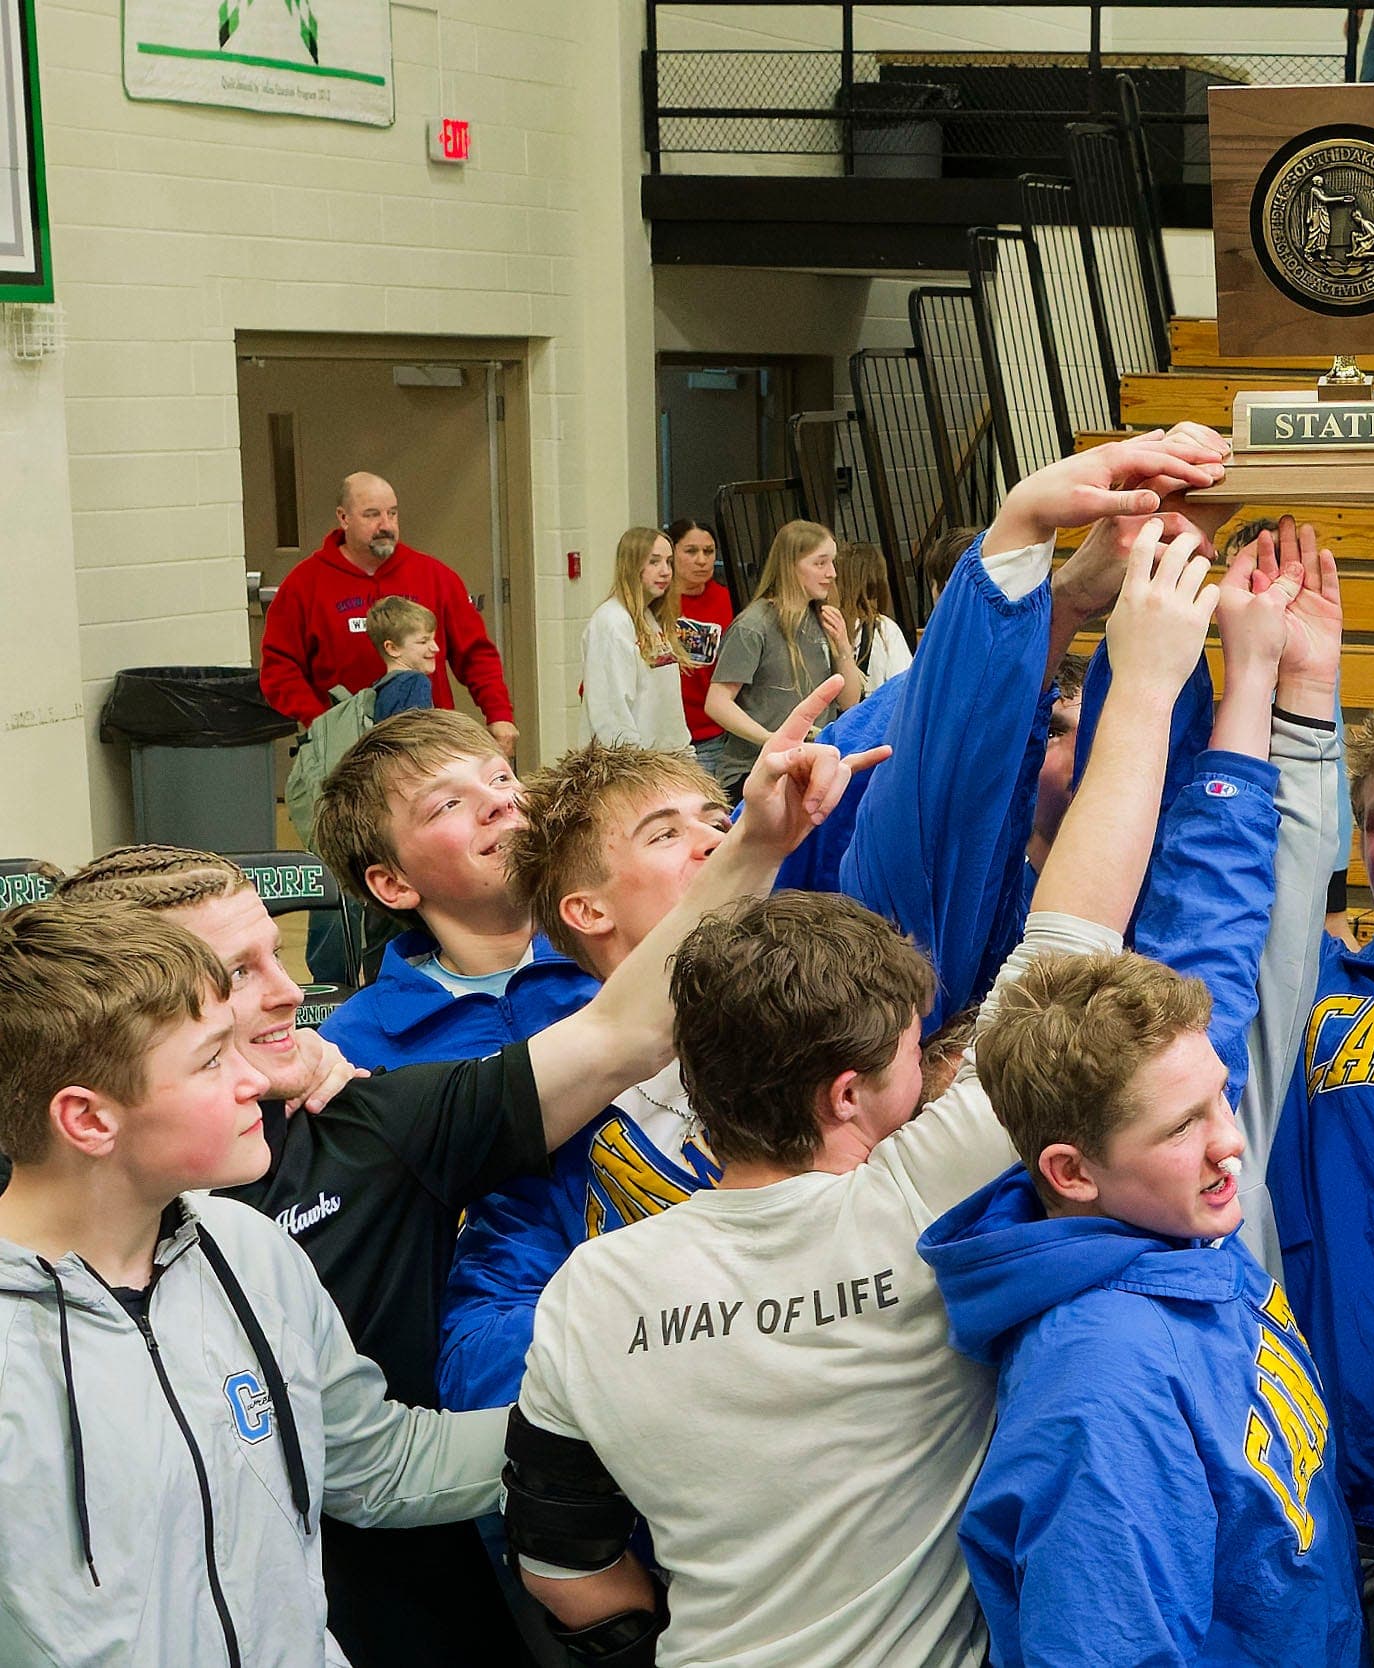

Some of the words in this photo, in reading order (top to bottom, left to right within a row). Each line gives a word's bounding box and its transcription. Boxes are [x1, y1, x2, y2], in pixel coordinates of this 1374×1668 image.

[275, 1191, 341, 1235] Hawks
[629, 1316, 648, 1354] A
[660, 1301, 744, 1346] WAY
[757, 1296, 805, 1335] OF
[813, 1269, 900, 1327] LIFE
